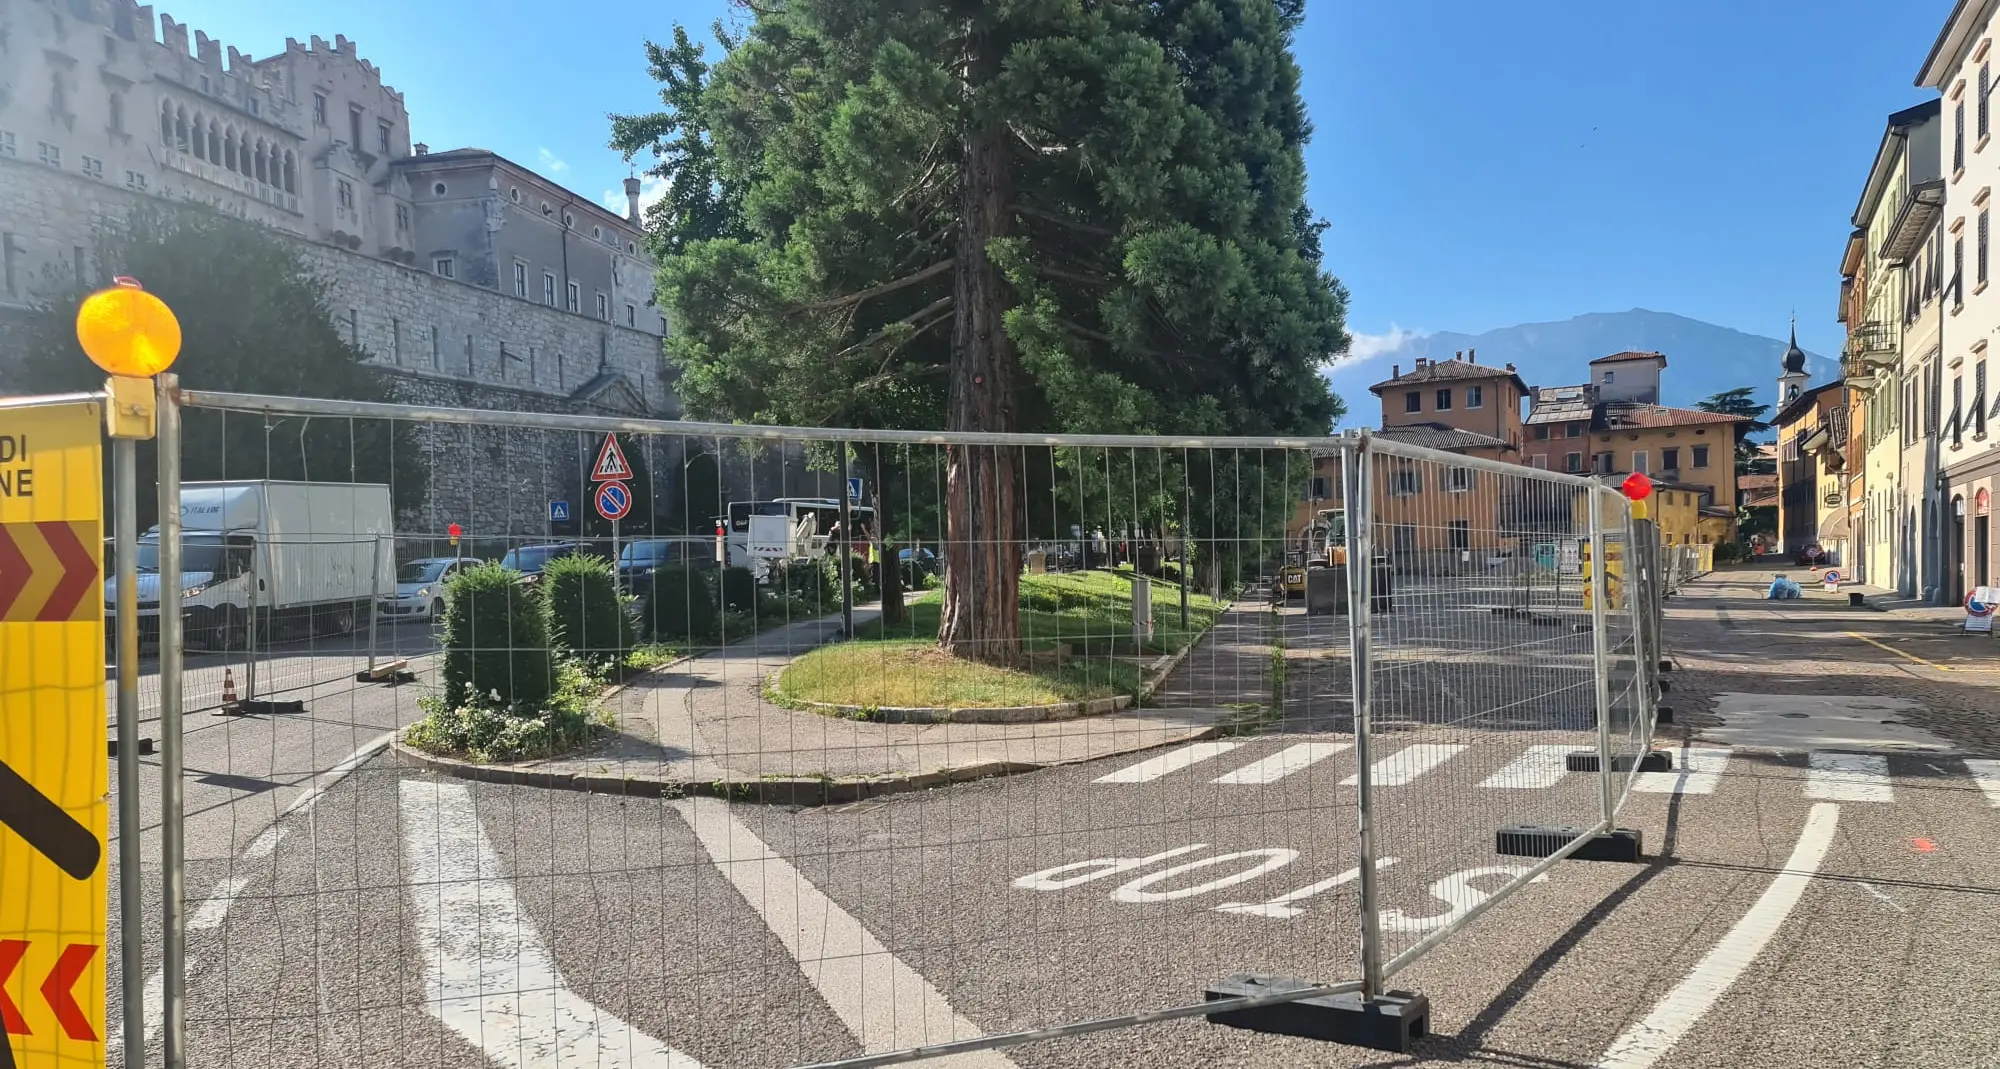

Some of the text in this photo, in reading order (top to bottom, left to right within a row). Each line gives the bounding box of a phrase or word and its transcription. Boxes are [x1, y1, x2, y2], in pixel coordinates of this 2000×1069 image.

[0, 434, 26, 463] DI
[1287, 574, 1301, 583] CAT
[1010, 843, 1550, 932] STOP
